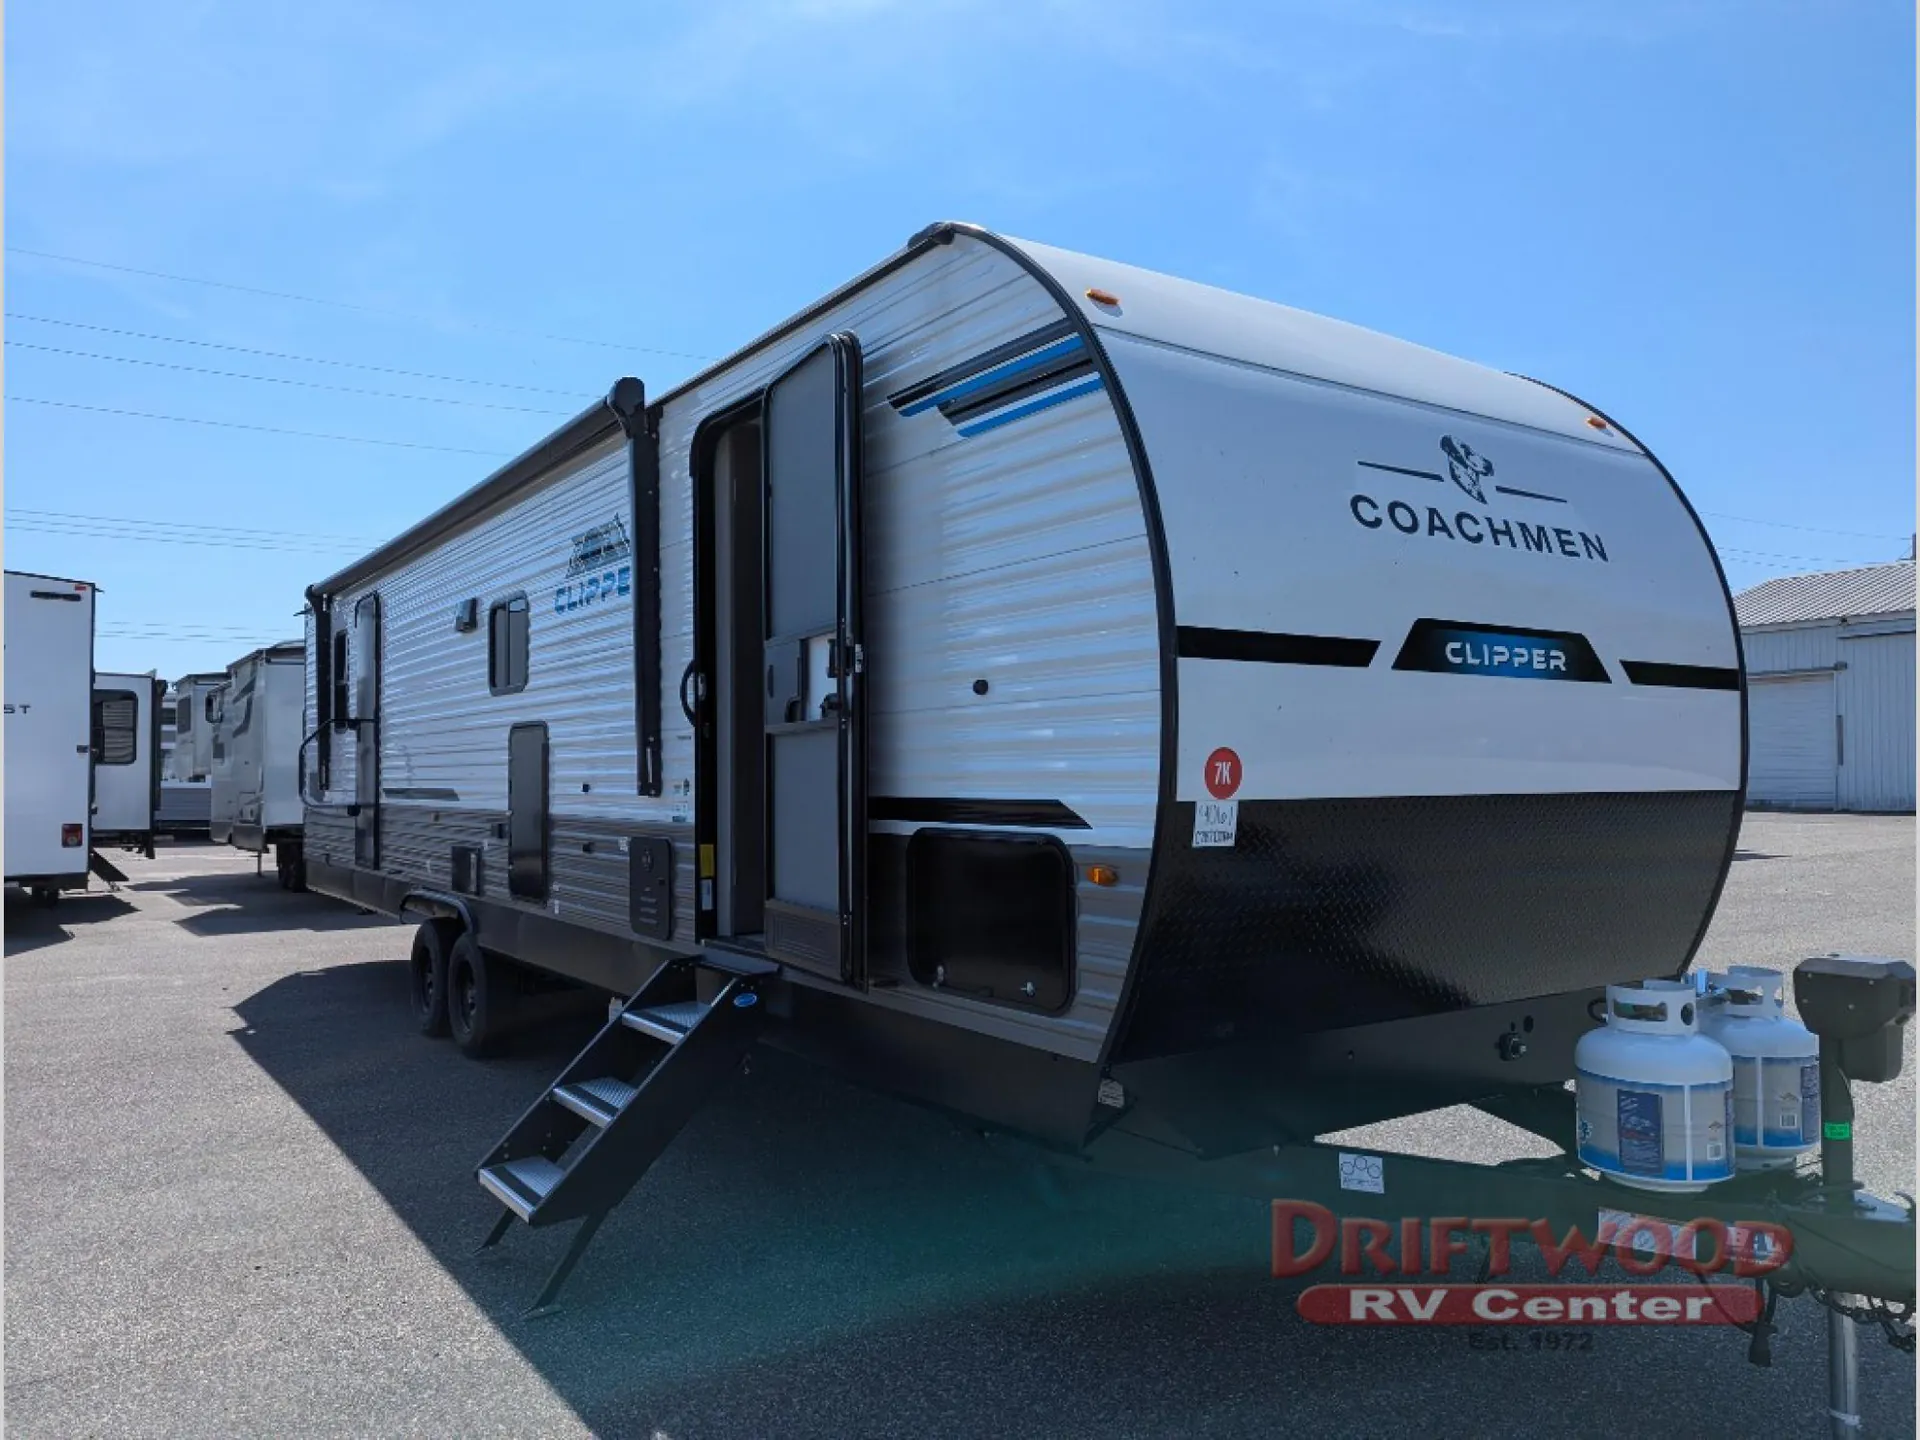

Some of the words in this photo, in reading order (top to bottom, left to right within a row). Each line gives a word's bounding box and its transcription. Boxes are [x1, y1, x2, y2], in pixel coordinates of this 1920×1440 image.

[1350, 494, 1609, 562] COACHMEN
[554, 566, 631, 614] CLIPPE
[1445, 641, 1567, 672] CLIPPER
[1214, 761, 1232, 786] 7K
